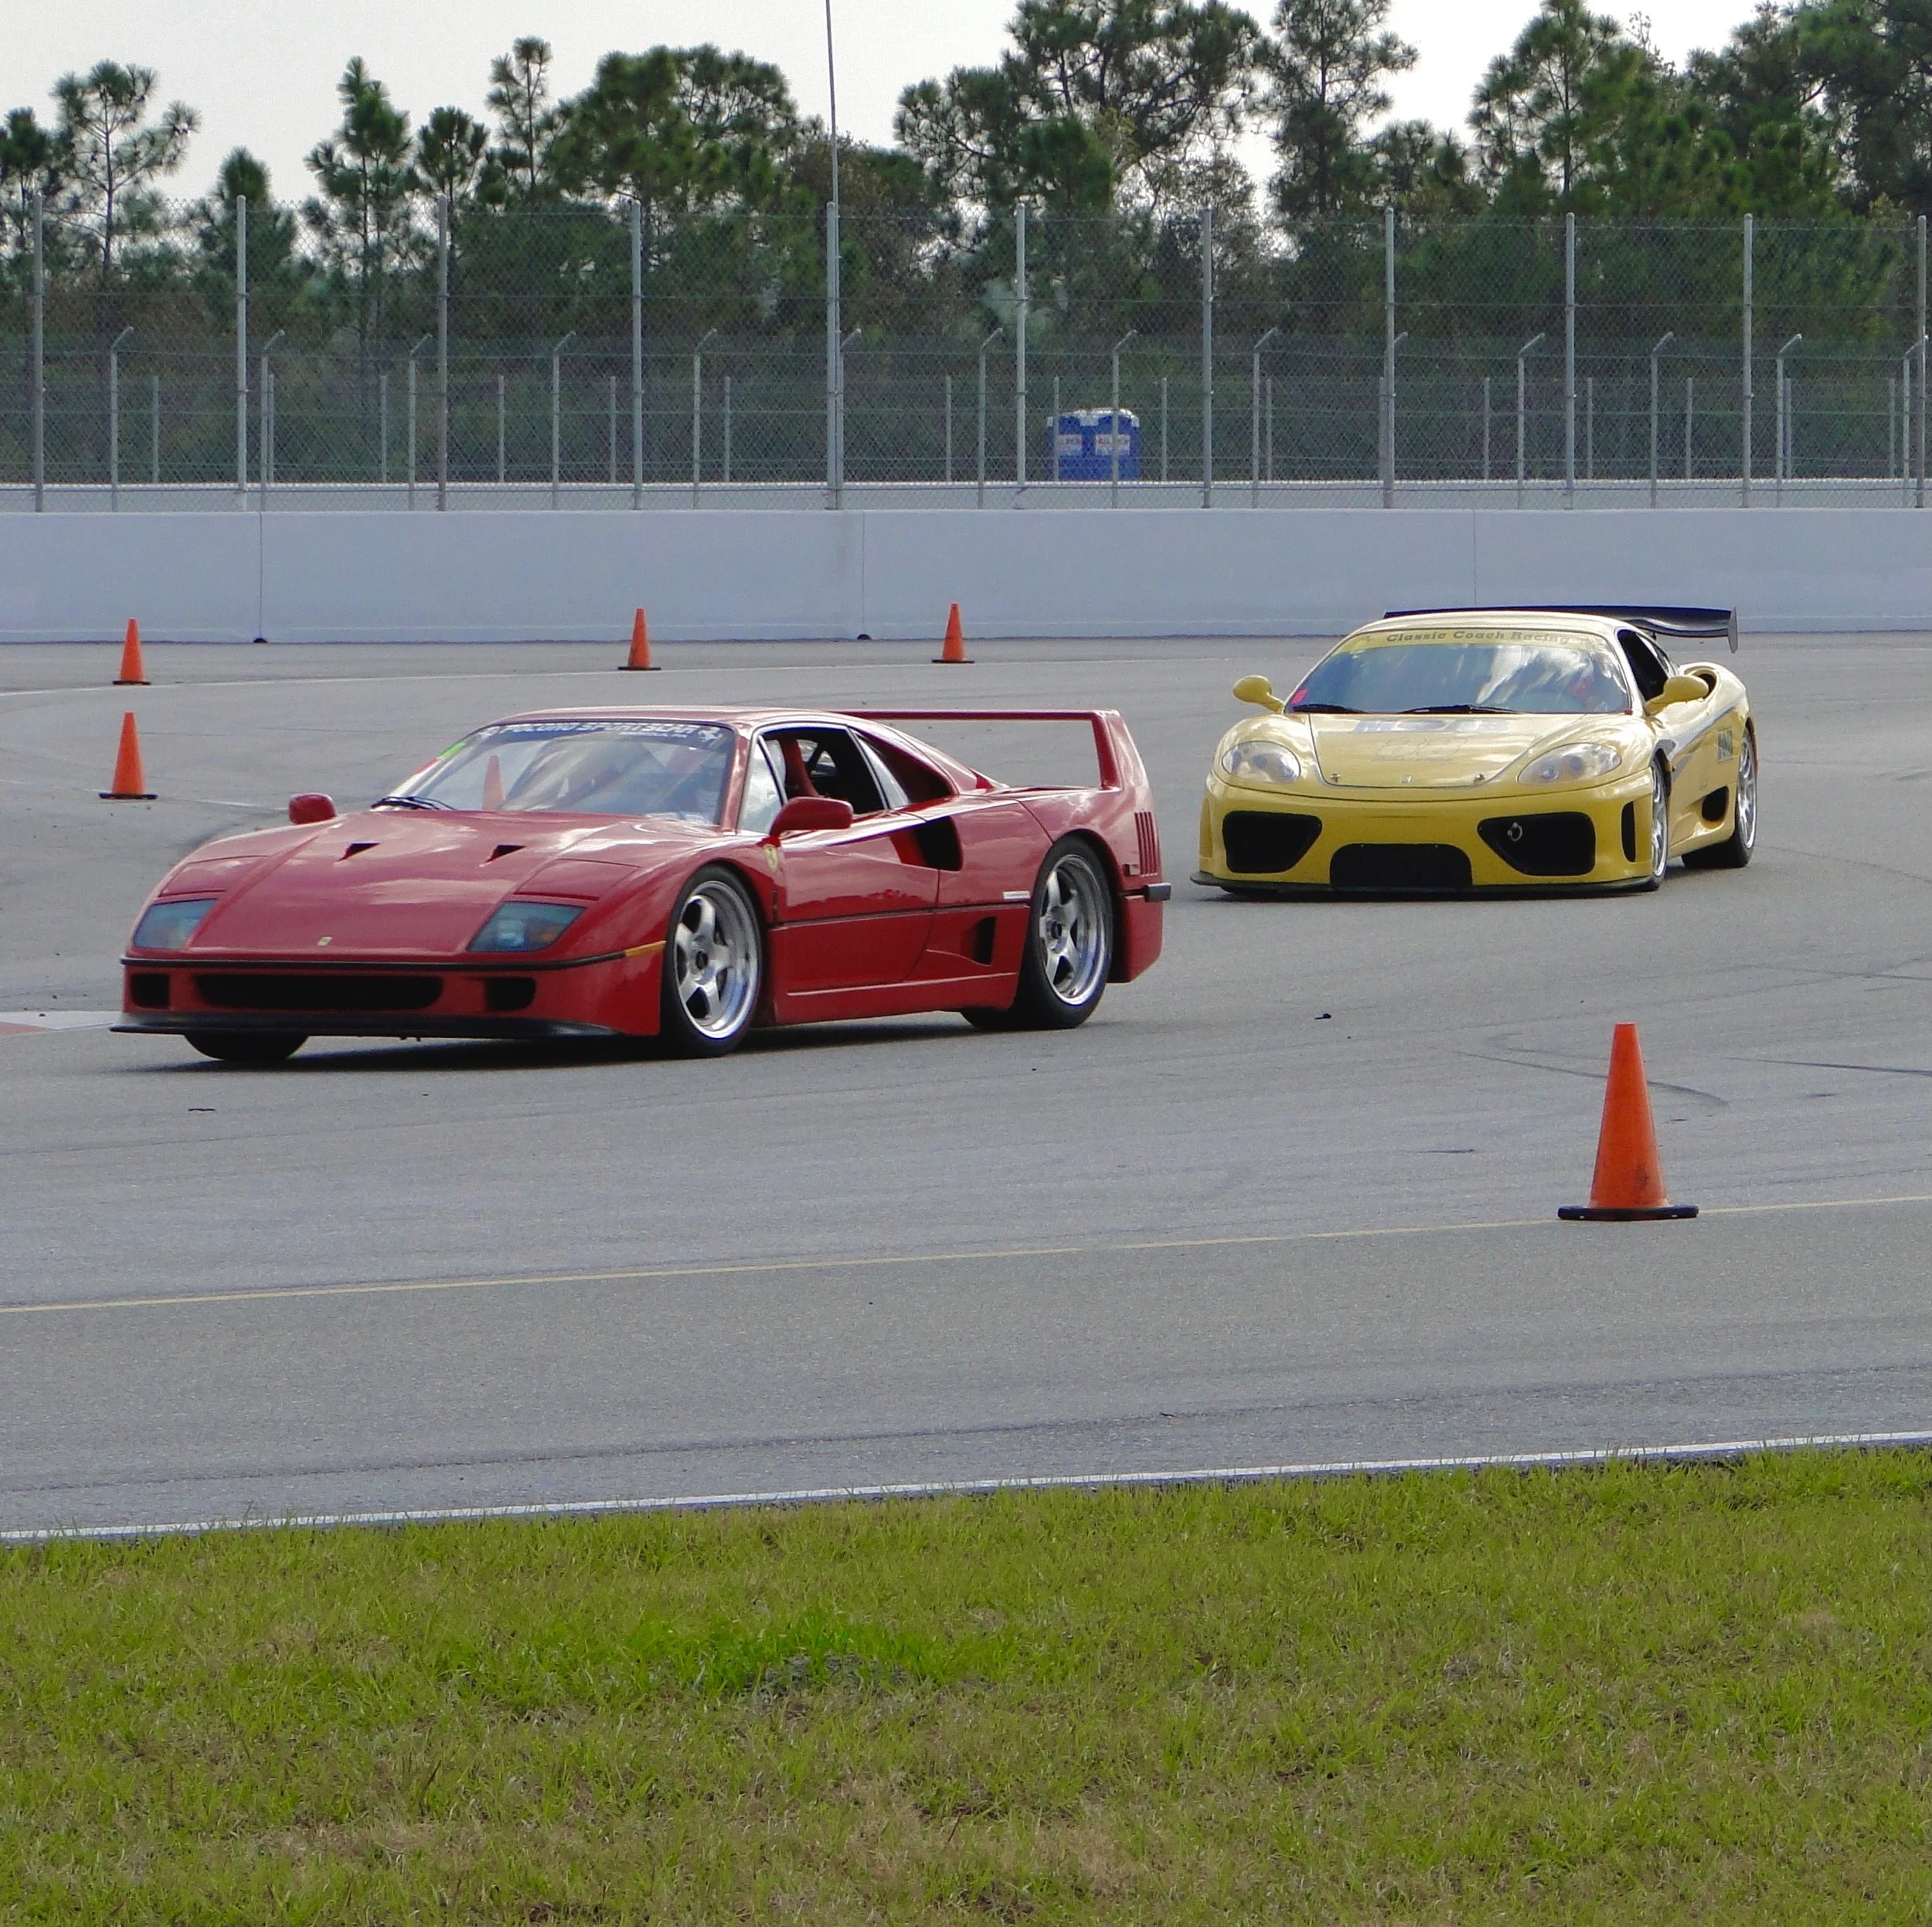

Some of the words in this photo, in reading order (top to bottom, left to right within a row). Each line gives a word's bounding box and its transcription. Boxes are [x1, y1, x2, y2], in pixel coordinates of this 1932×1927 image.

[1386, 631, 1447, 642] Classic
[1453, 630, 1505, 640] Coach
[1510, 631, 1571, 645] Racing
